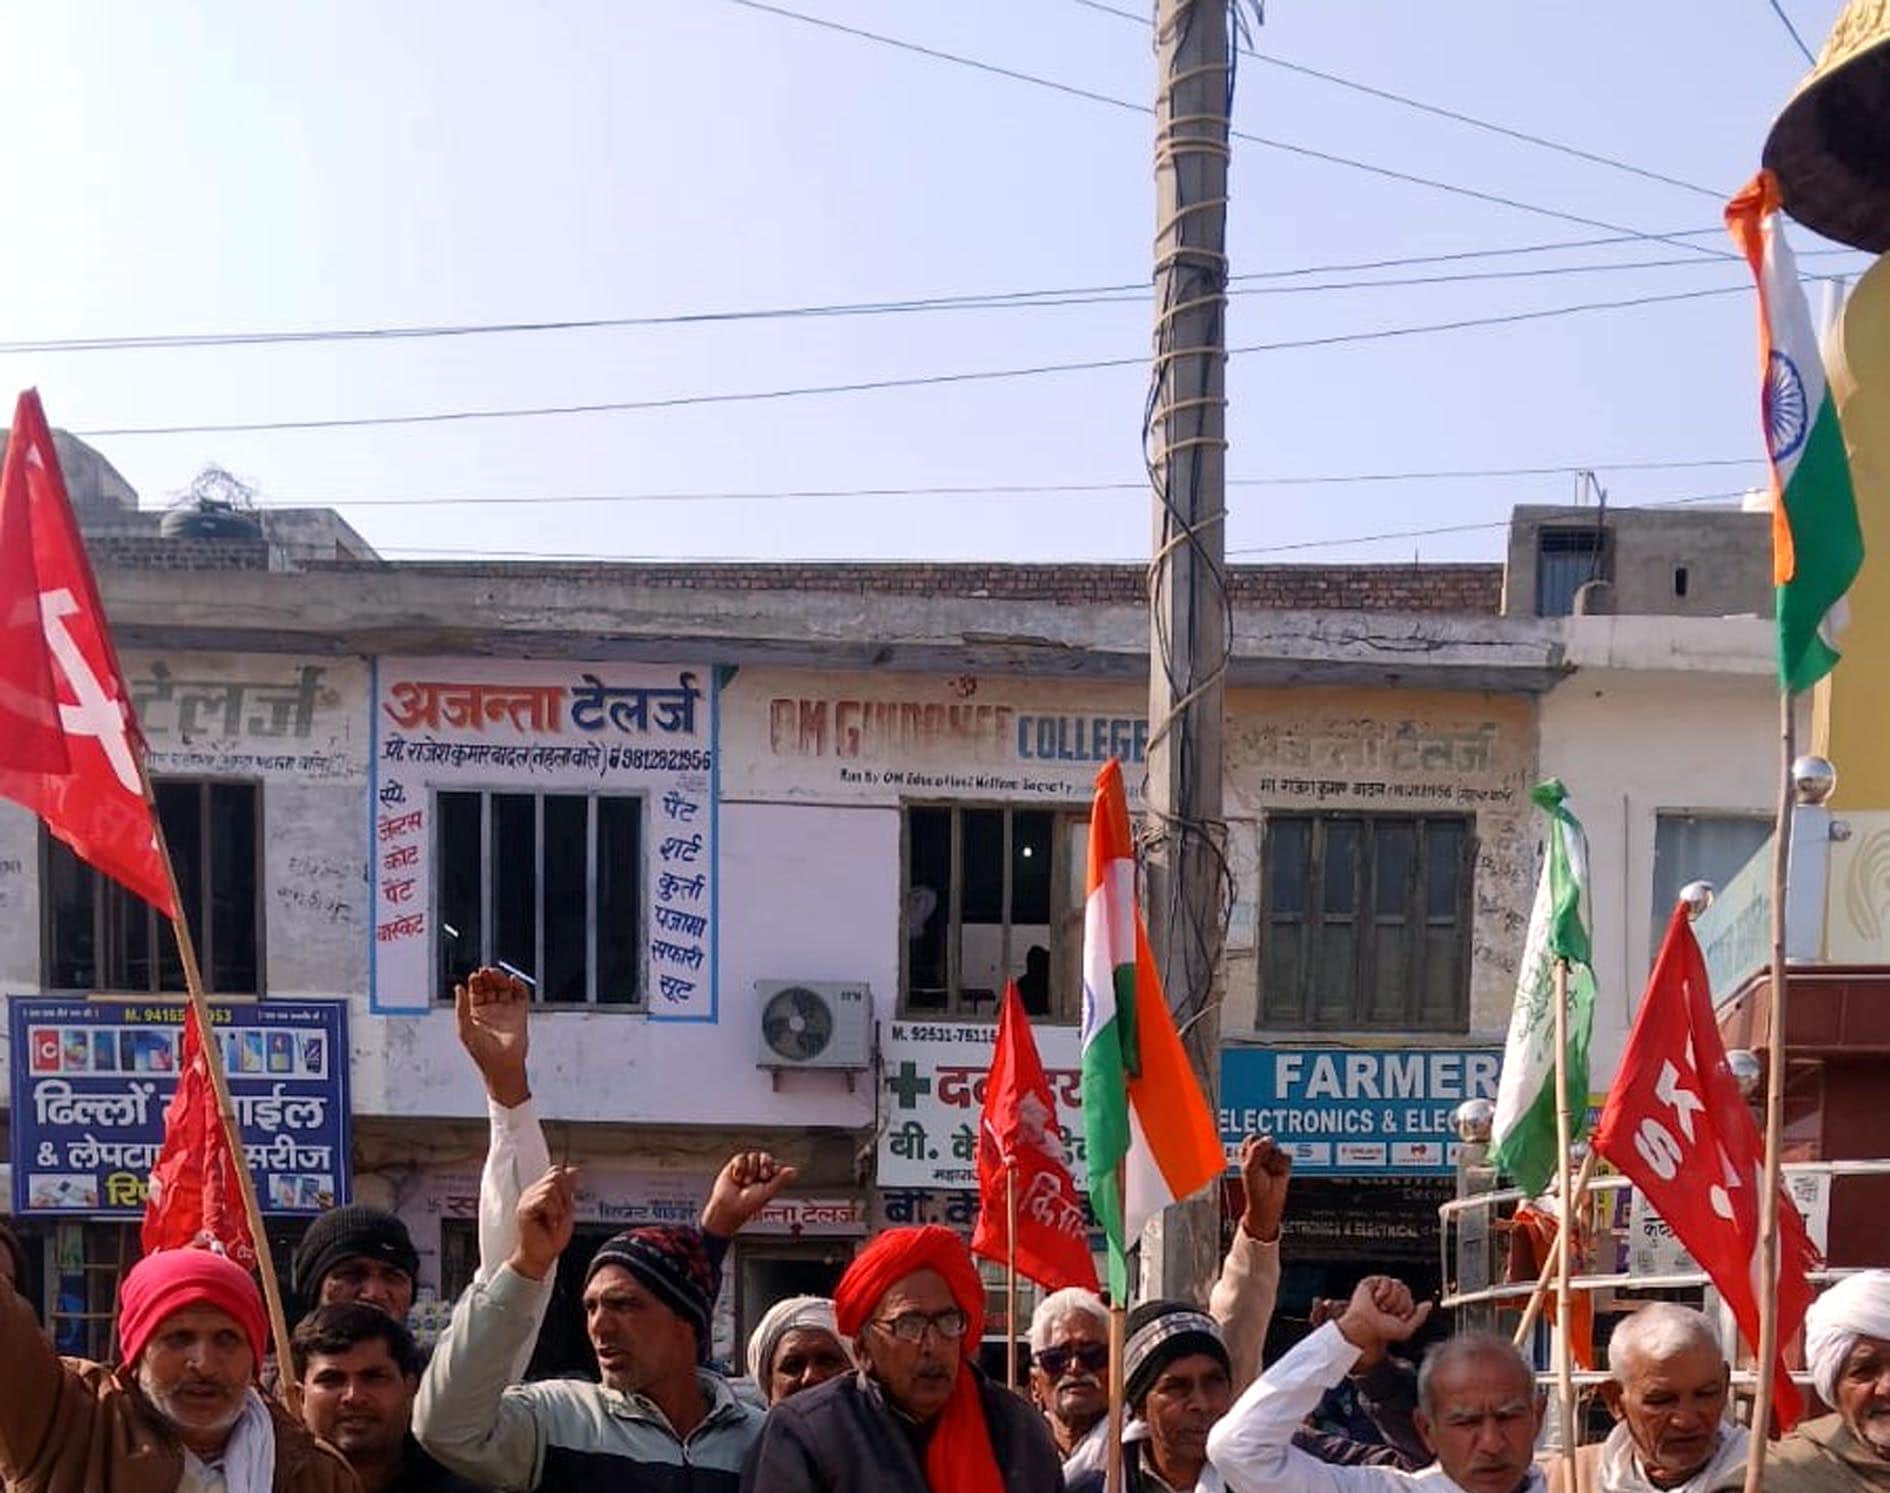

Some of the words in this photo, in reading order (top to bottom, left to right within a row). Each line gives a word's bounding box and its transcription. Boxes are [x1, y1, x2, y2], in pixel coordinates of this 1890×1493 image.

[382, 681, 565, 733] अजन्ता
[571, 671, 702, 735] टेलर्ज
[407, 734, 450, 765] राजेश
[1276, 1054, 1498, 1099] FARMER
[1220, 1108, 1373, 1134] ELECTRONICS
[1382, 1109, 1398, 1134] &
[37, 1142, 59, 1167] &
